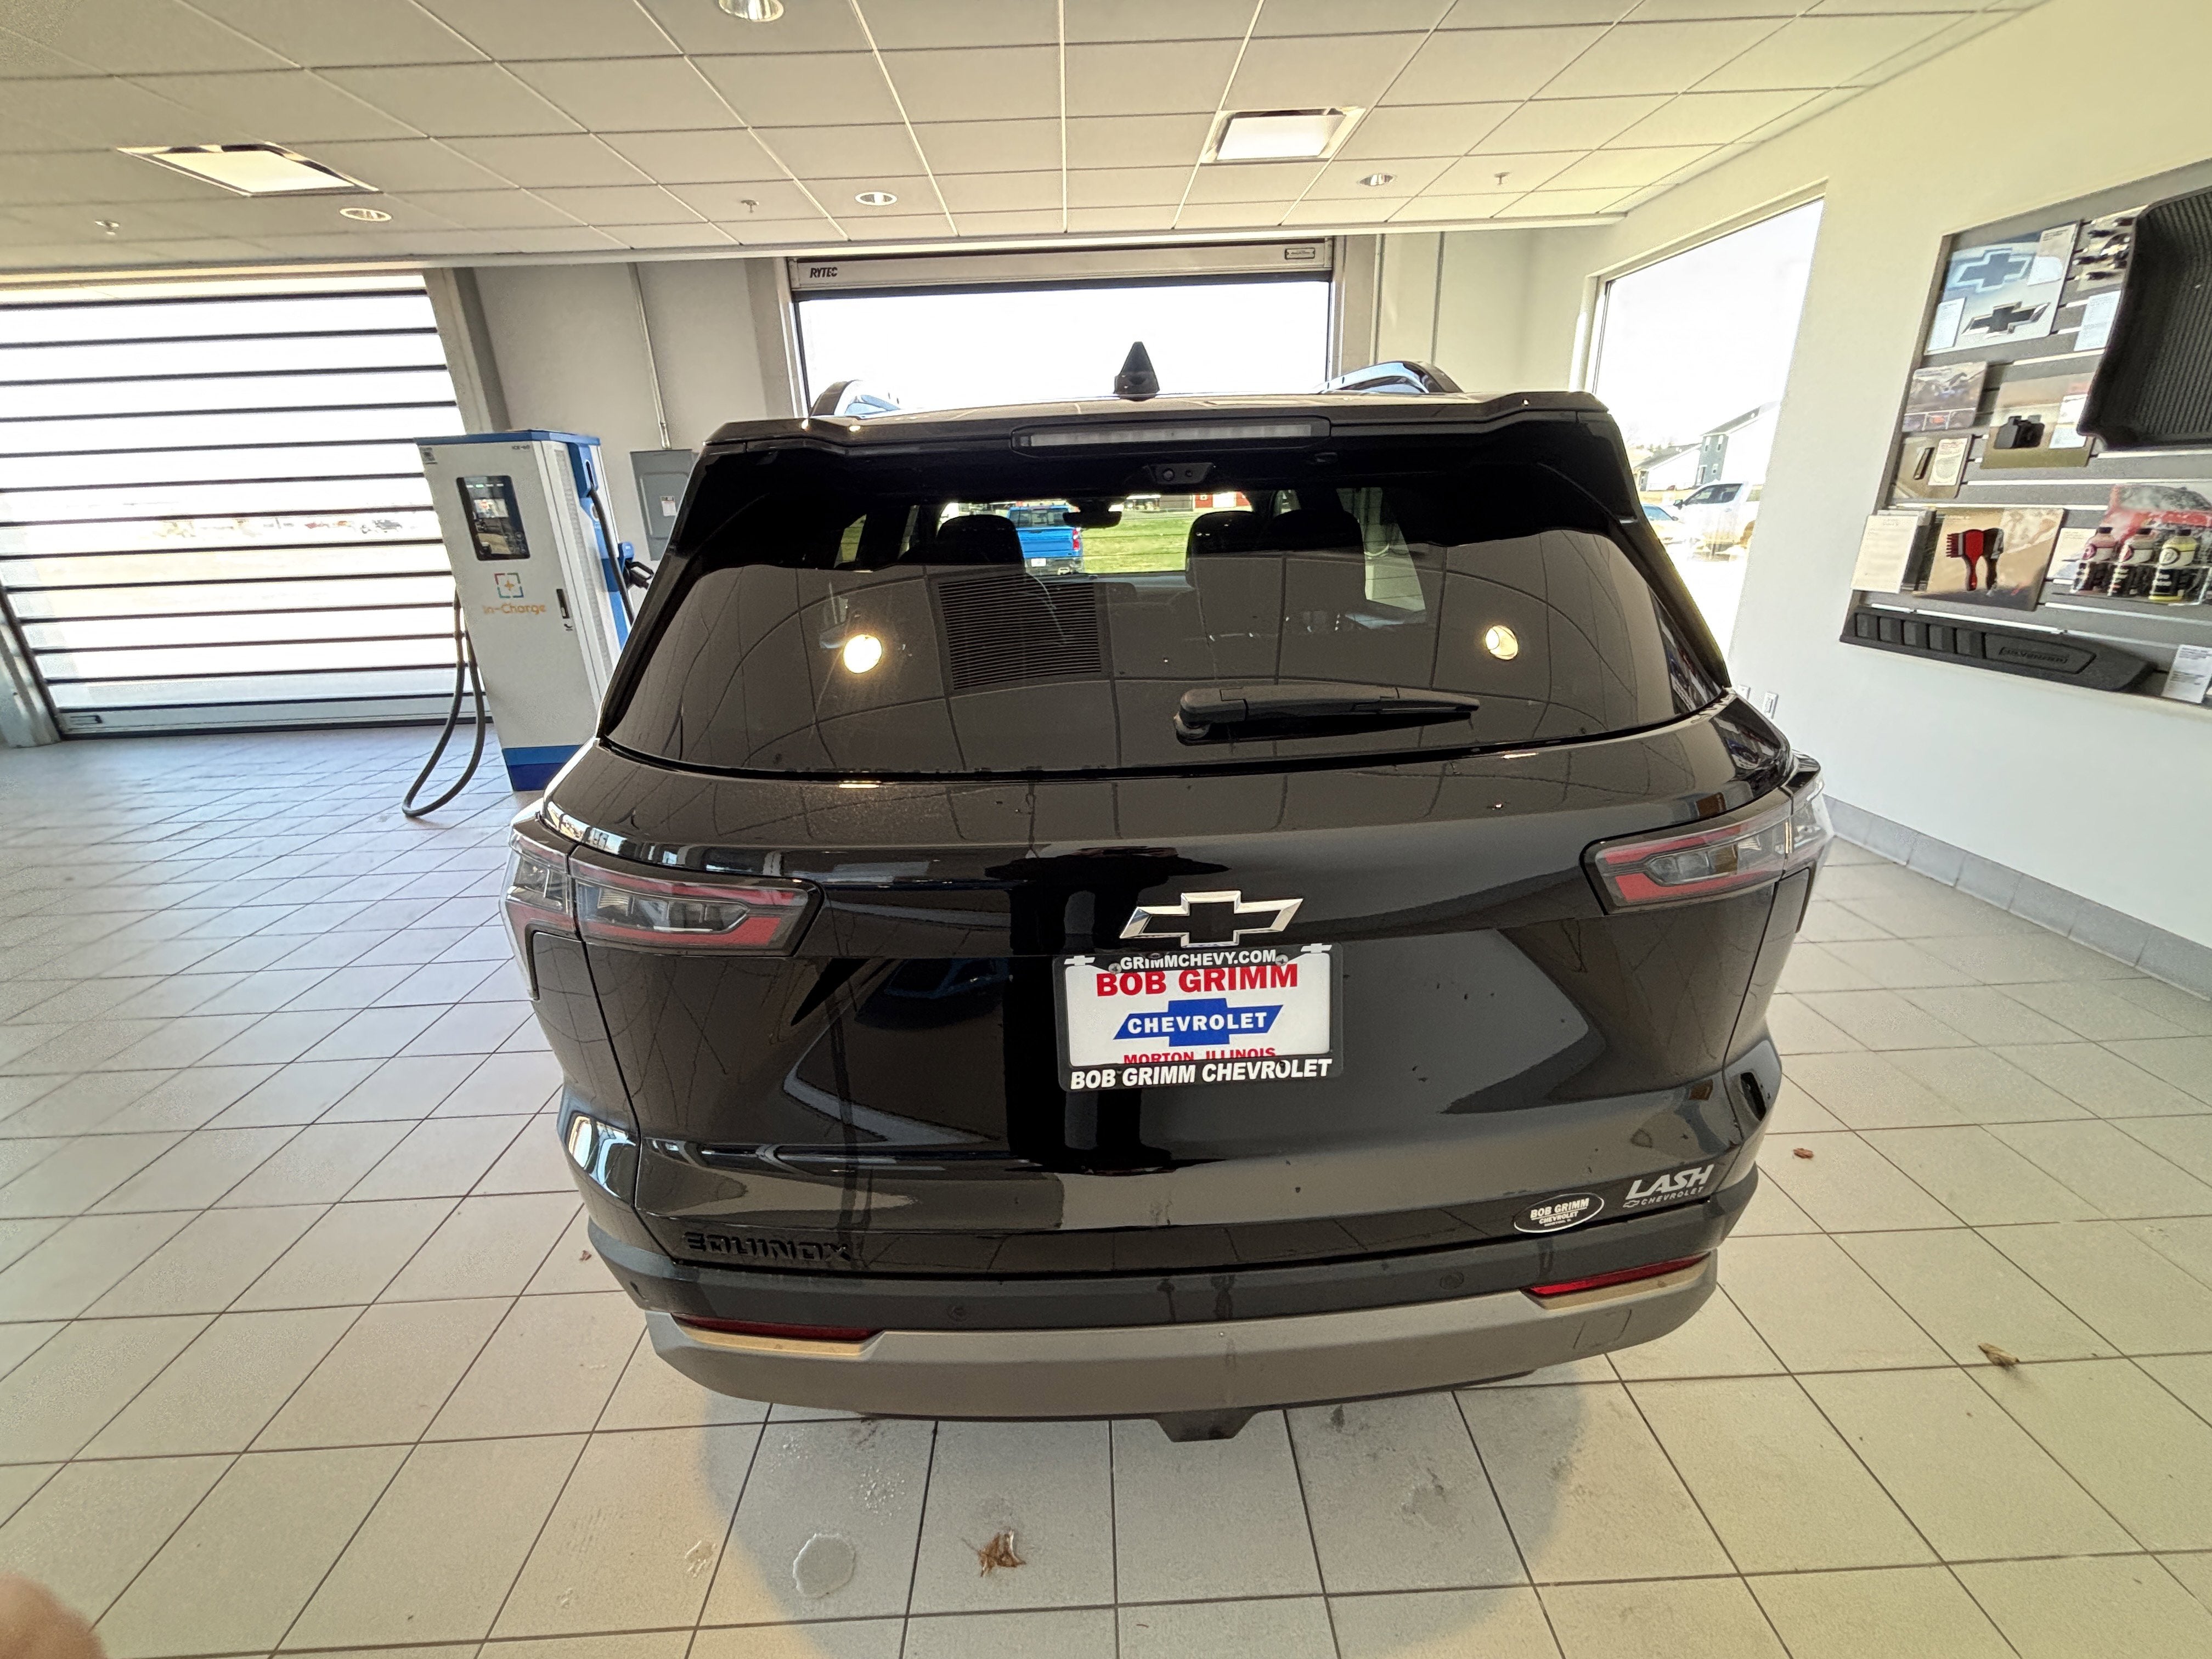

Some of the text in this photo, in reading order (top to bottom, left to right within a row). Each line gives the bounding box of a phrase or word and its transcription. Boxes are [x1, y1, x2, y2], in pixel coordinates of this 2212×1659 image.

[810, 267, 838, 278] RYTEC
[1120, 950, 1276, 970] GRIMMCHEVY.COM
[1097, 963, 1299, 997] BOB GRIMM
[1127, 1012, 1267, 1034] CHEVROLET
[1070, 1059, 1333, 1090] BOB GRIMM CHEVROLET
[1626, 1164, 1714, 1200] LASH
[1641, 1187, 1704, 1205] CHEVROLET
[1530, 1198, 1589, 1218] BOB GRIMM
[1539, 1211, 1579, 1224] CHEVROLET
[684, 1232, 851, 1261] EQUINOX
